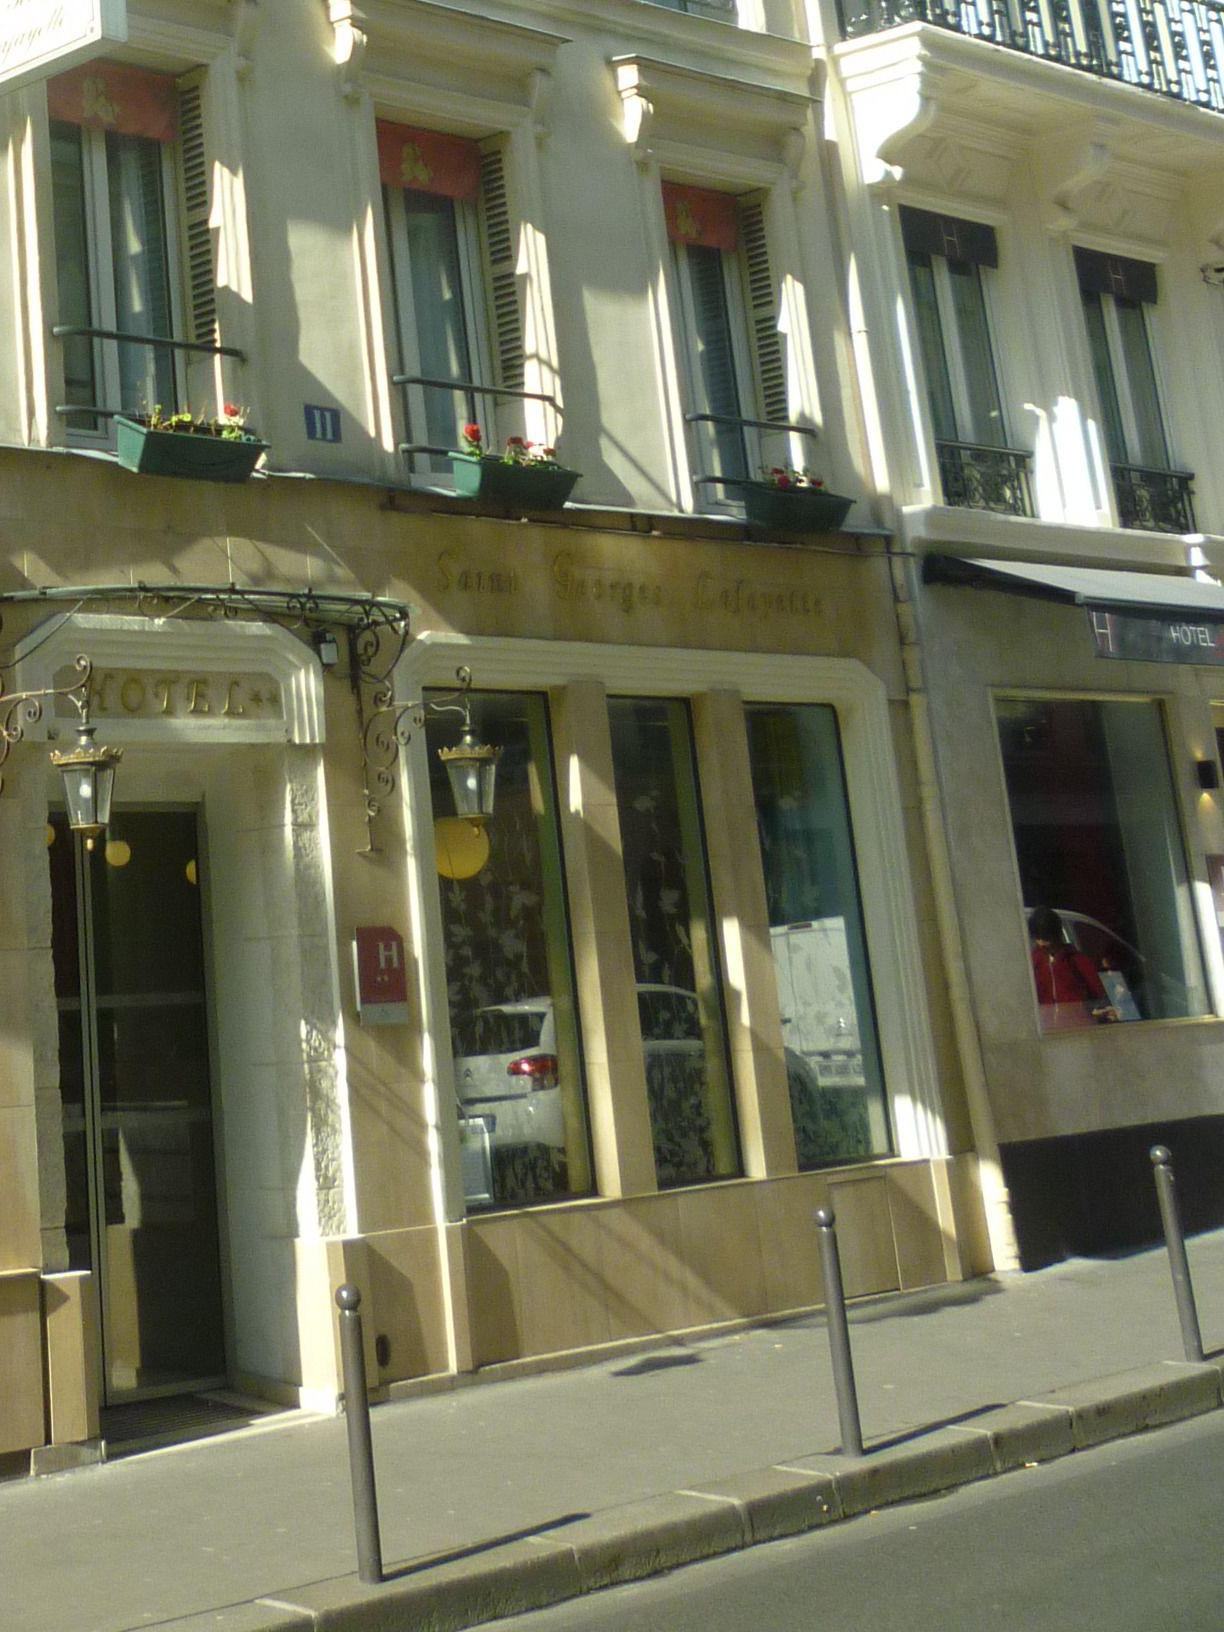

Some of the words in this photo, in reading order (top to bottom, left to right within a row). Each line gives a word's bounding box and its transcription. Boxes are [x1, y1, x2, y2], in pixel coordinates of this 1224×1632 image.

[940, 218, 961, 258] H
[1090, 611, 1115, 653] H
[88, 672, 246, 716] HOTEL
[376, 941, 399, 969] H
